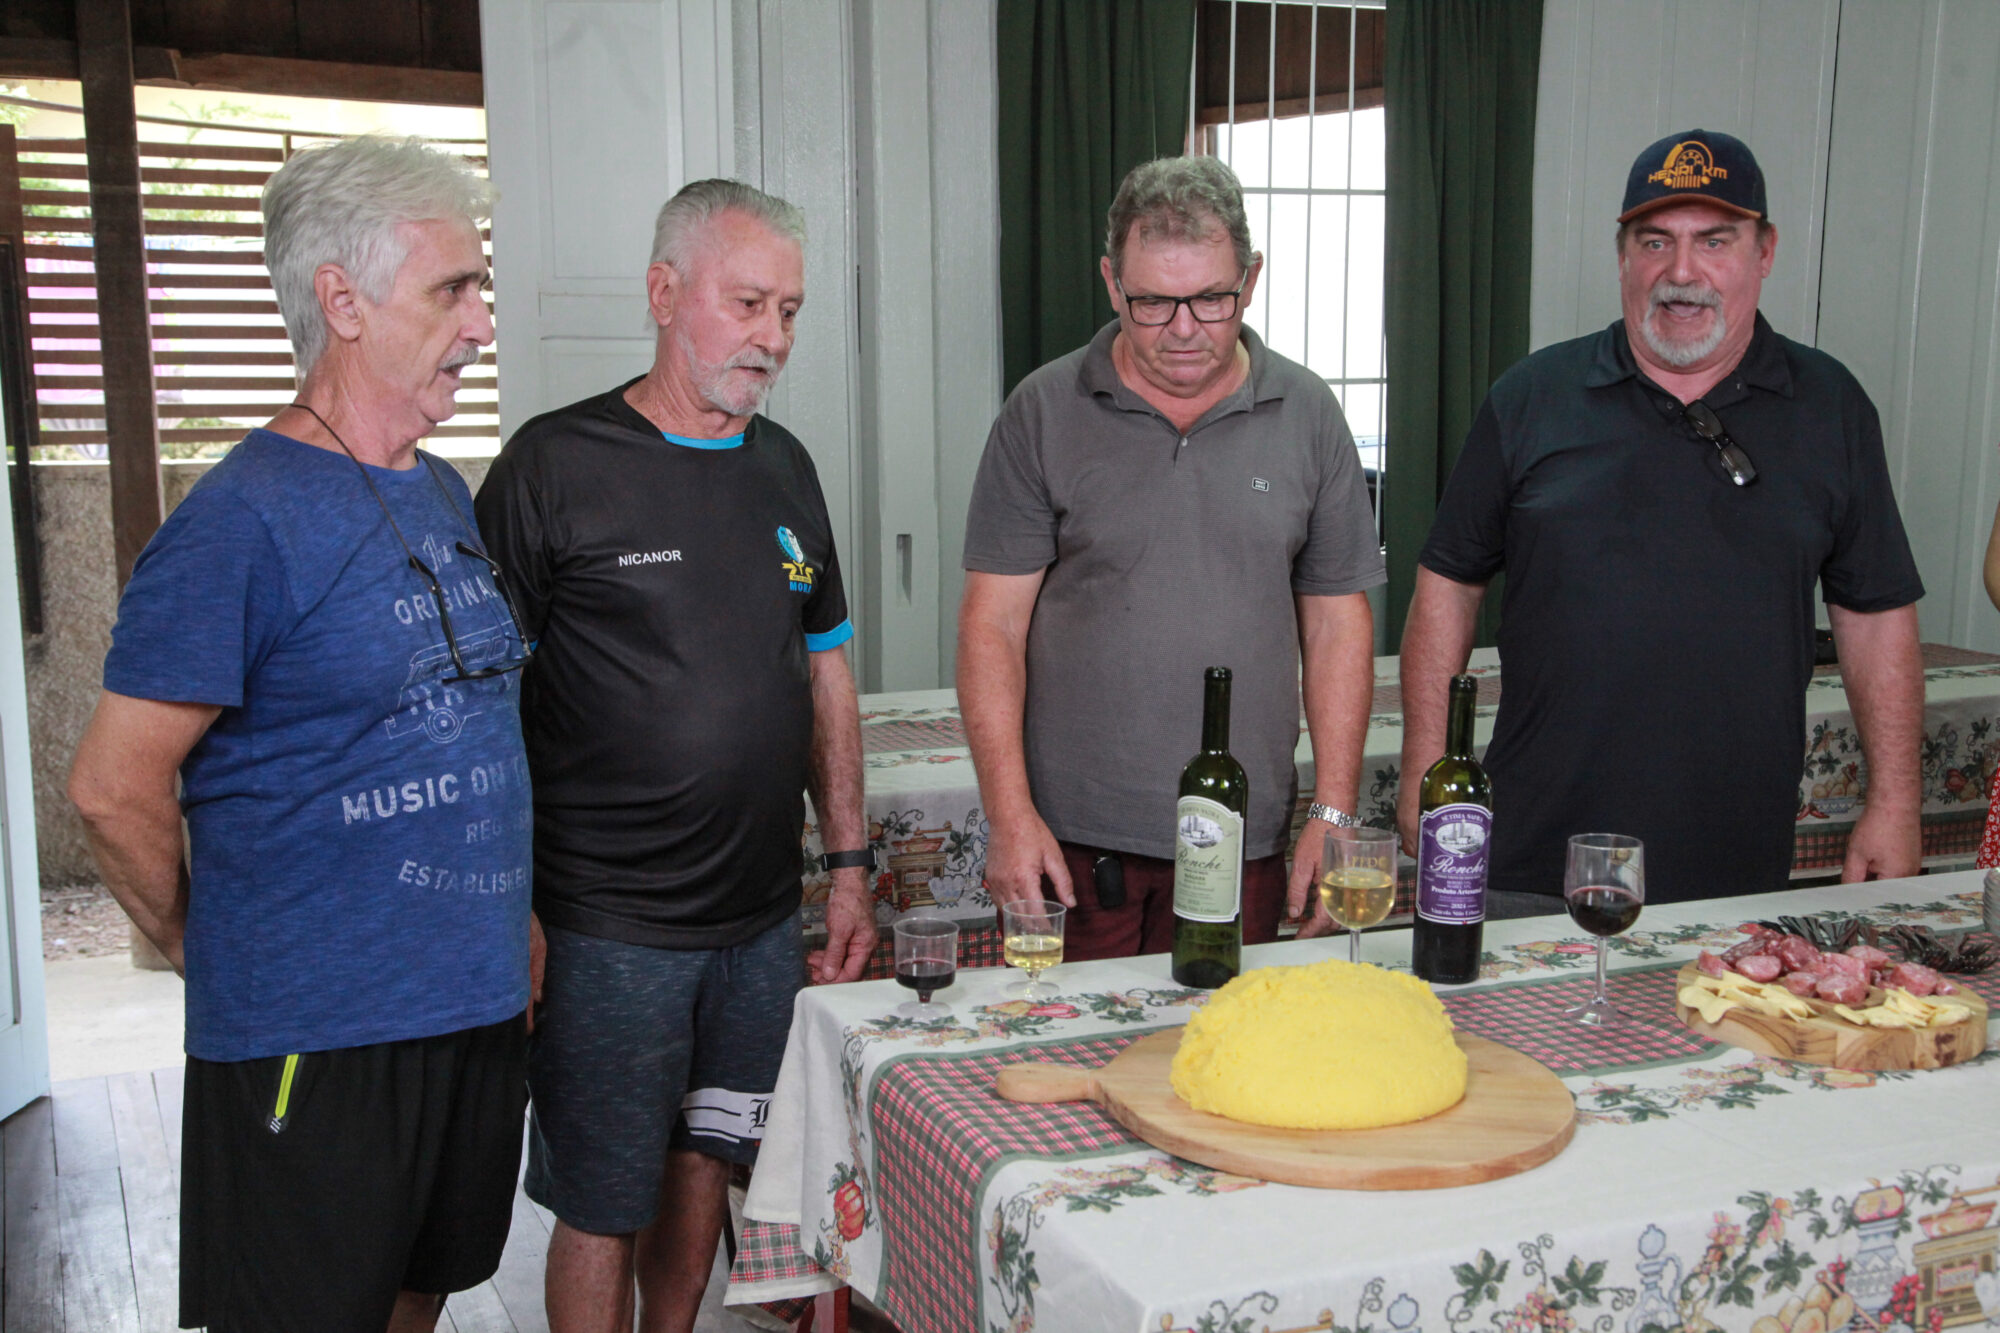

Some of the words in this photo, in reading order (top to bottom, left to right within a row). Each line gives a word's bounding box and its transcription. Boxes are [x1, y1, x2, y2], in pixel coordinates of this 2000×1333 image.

[618, 550, 683, 567] NICANOR
[341, 773, 460, 825] MUSIC
[471, 760, 506, 796] ON
[1430, 855, 1485, 874] Ronchi
